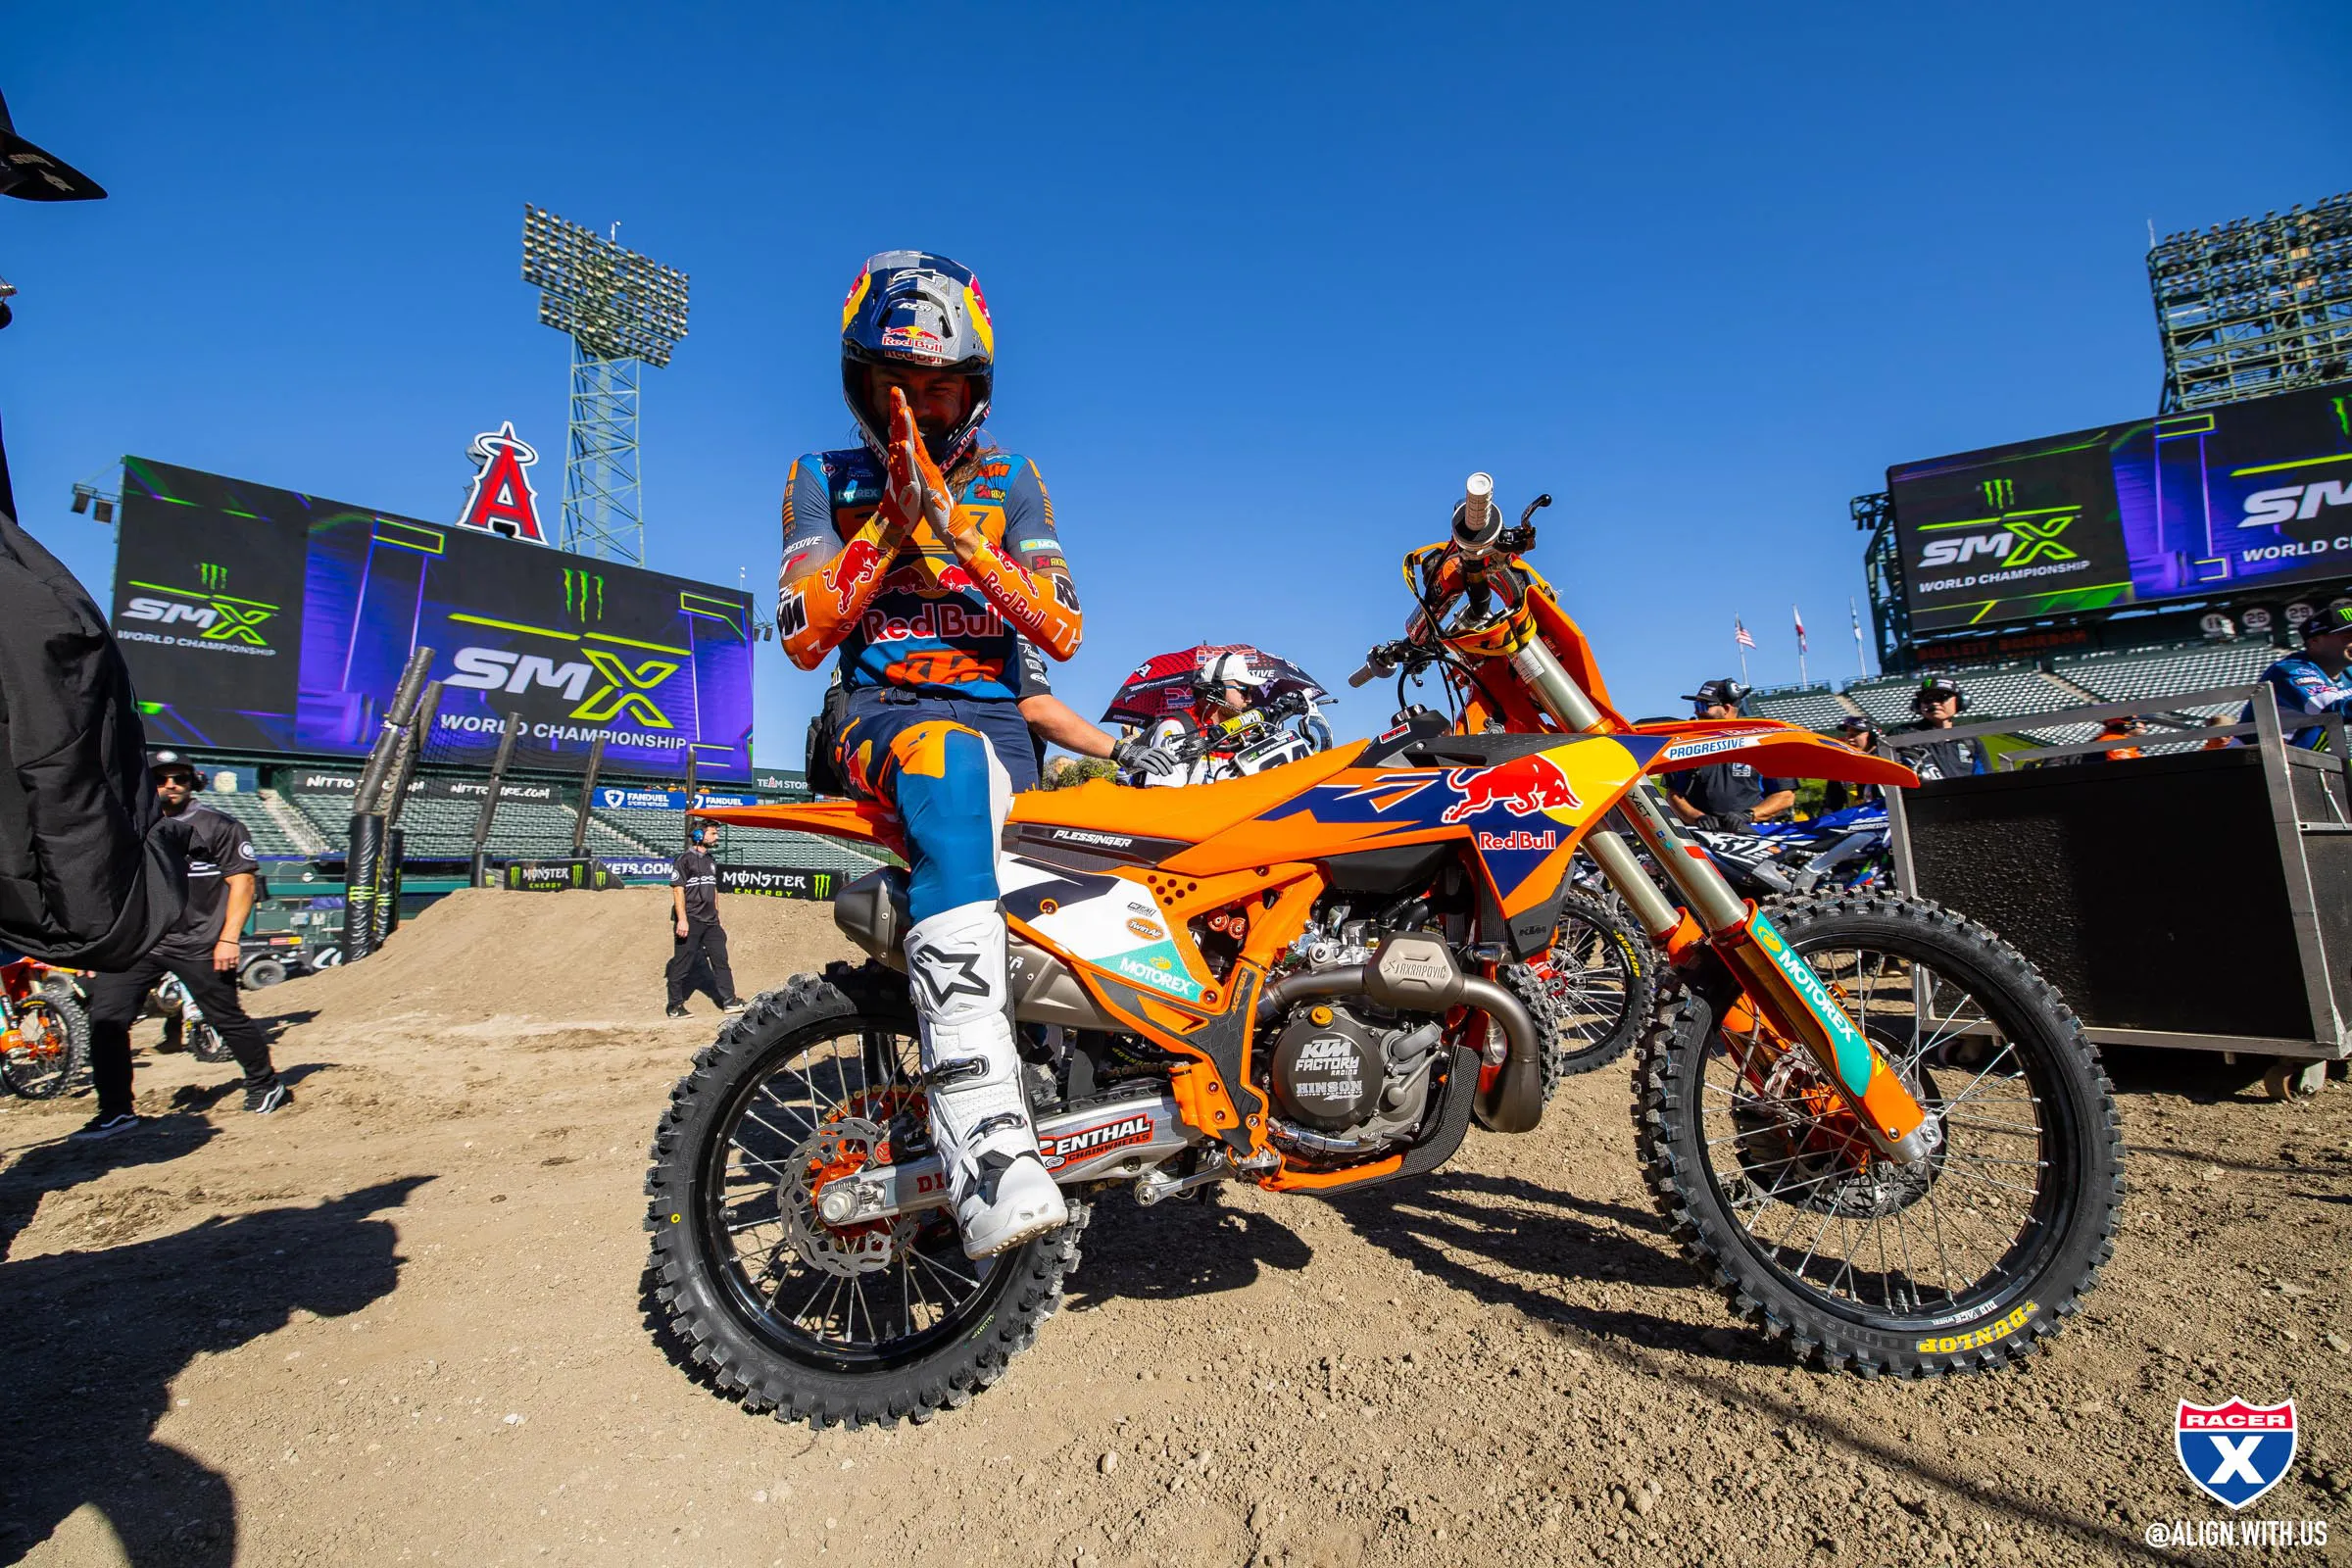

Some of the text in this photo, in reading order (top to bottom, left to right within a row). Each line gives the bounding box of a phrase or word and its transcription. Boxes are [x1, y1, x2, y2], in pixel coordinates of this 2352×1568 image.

[883, 336, 944, 353] Red Bull
[1917, 515, 2078, 567] SMX
[2242, 540, 2328, 563] WORLD
[1918, 561, 2090, 593] WORLD CHAMPIONSHIP
[983, 571, 1019, 609] Red
[1011, 596, 1048, 630] Bull
[121, 597, 271, 646] SMX
[861, 603, 937, 645] Red
[938, 604, 1004, 638] Bull
[118, 629, 276, 657] WORLD CHAMPIONSHIP
[885, 650, 1004, 686] KTM
[440, 647, 680, 728] SMX
[533, 722, 687, 751] CHAMPIONSHIP
[1669, 737, 1745, 760] PROGRESSIVE
[627, 792, 669, 803] FANDUEL
[706, 796, 743, 806] FANDUEL
[1053, 830, 1133, 851] PLESSINGER
[1479, 830, 1556, 851] Red Bull
[522, 867, 569, 880] MONSTER
[722, 870, 807, 890] MONSTER
[734, 887, 793, 898] ENERGY
[1119, 956, 1192, 996] MOTOREX
[1779, 949, 1856, 1043] MOTOREX
[1300, 1038, 1351, 1059] KTM
[1295, 1055, 1360, 1072] FACTORY
[1296, 1080, 1363, 1094] HINSON
[1068, 1134, 1151, 1161] CHAINWHEELS
[1918, 1305, 2030, 1353] DUNLOP
